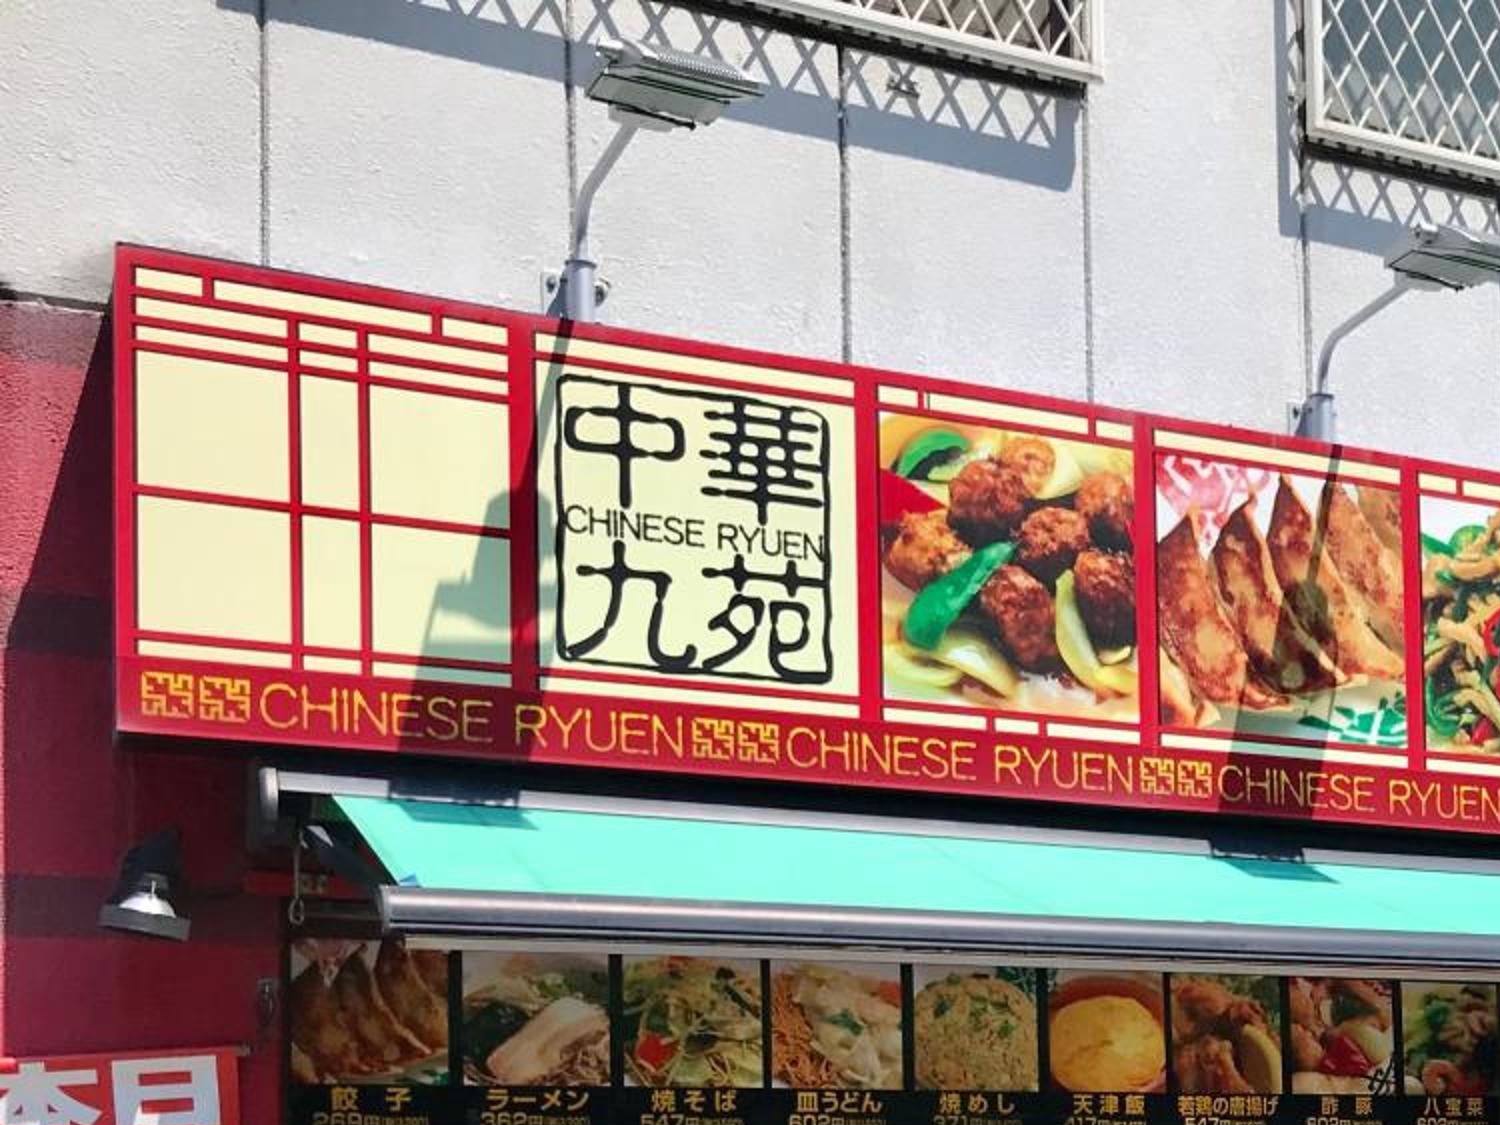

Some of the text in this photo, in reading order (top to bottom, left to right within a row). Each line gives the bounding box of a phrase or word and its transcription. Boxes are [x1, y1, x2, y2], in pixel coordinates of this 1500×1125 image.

[564, 385, 824, 523] 中華
[565, 503, 823, 562] CHINESE RYUEN
[563, 540, 828, 675] 九苑
[260, 682, 492, 745] CHINESE
[516, 700, 685, 761] RYUEN
[786, 727, 977, 781] CHINESE
[994, 744, 1136, 796] RYUEN
[1218, 764, 1374, 812] CHINESE
[331, 1086, 412, 1113] 餃子
[487, 1088, 590, 1112] ラーメン
[651, 1089, 737, 1113] 焼そば
[797, 1091, 882, 1114] 皿うどん
[940, 1092, 1015, 1115] 焼めし
[1073, 1094, 1145, 1116] 天津飯
[1178, 1095, 1279, 1117] 若鶏の唐揚げ
[1424, 1096, 1485, 1116] 八宝菜
